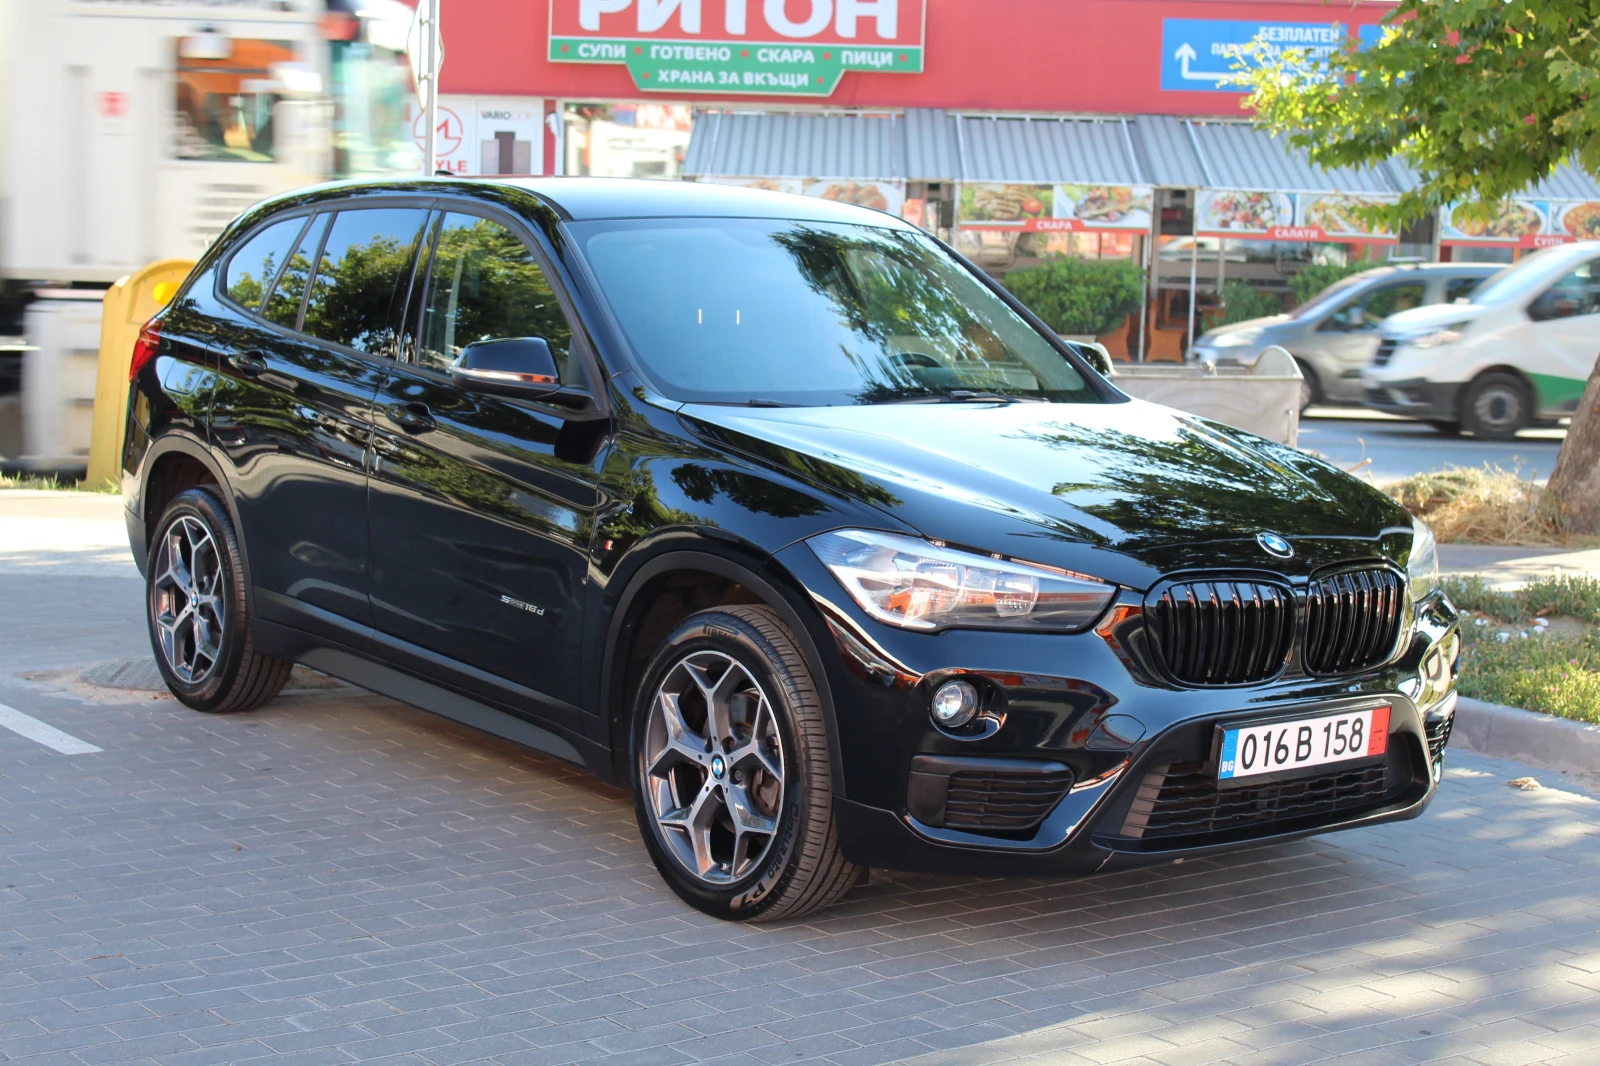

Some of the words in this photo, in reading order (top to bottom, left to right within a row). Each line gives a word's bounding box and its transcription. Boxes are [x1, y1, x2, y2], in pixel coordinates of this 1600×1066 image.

[1259, 26, 1340, 42] БЕЗПЛАТЕН
[577, 43, 627, 59] СУПИ
[650, 45, 731, 61] ГОТВЕНО
[757, 48, 815, 64] СКАРА
[841, 50, 894, 68] ПИЦИ
[658, 69, 715, 85] ХРАНА
[718, 71, 740, 86] ЗА
[743, 72, 809, 88] ВКЪЩИ
[1036, 221, 1073, 231] СКАРА
[1274, 227, 1319, 240] САЛАТИ
[1221, 760, 1234, 773] BG
